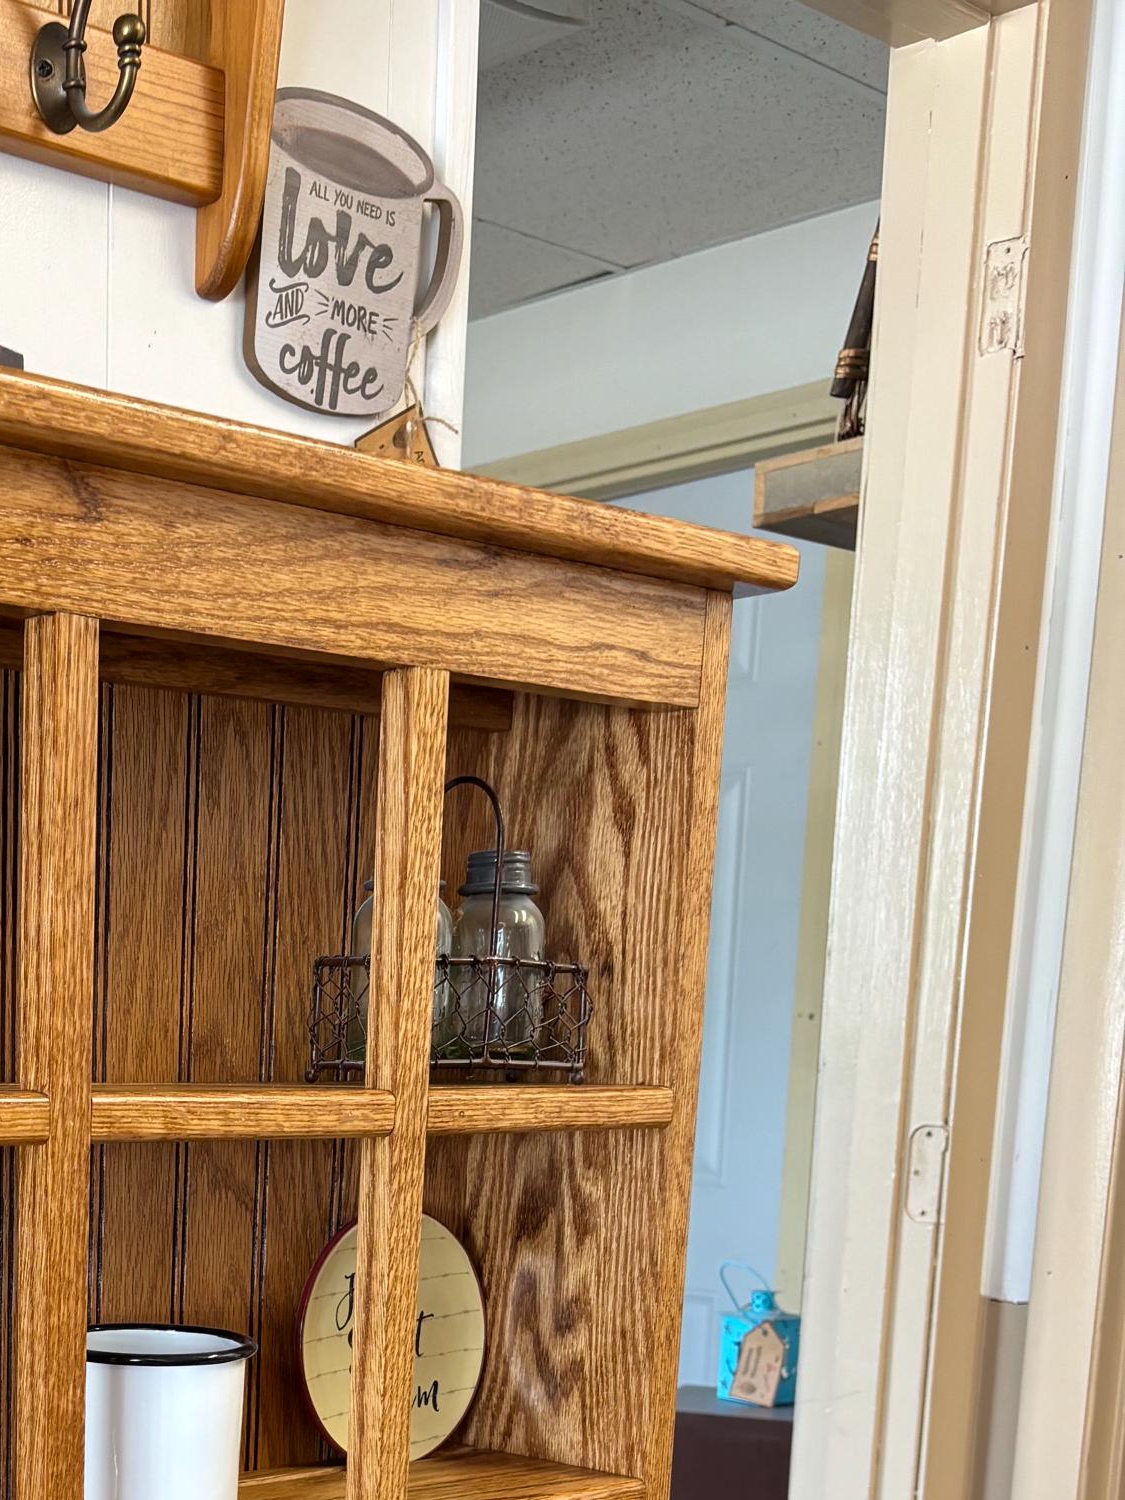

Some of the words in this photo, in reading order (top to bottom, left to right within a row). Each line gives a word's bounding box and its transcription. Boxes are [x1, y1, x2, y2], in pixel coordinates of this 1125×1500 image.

[309, 181, 330, 203] ALL
[334, 190, 354, 210] YOU
[356, 199, 382, 220] NEED
[385, 209, 396, 227] IS
[273, 289, 305, 320] AND
[331, 299, 379, 335] MORE
[279, 328, 384, 410] coffee
